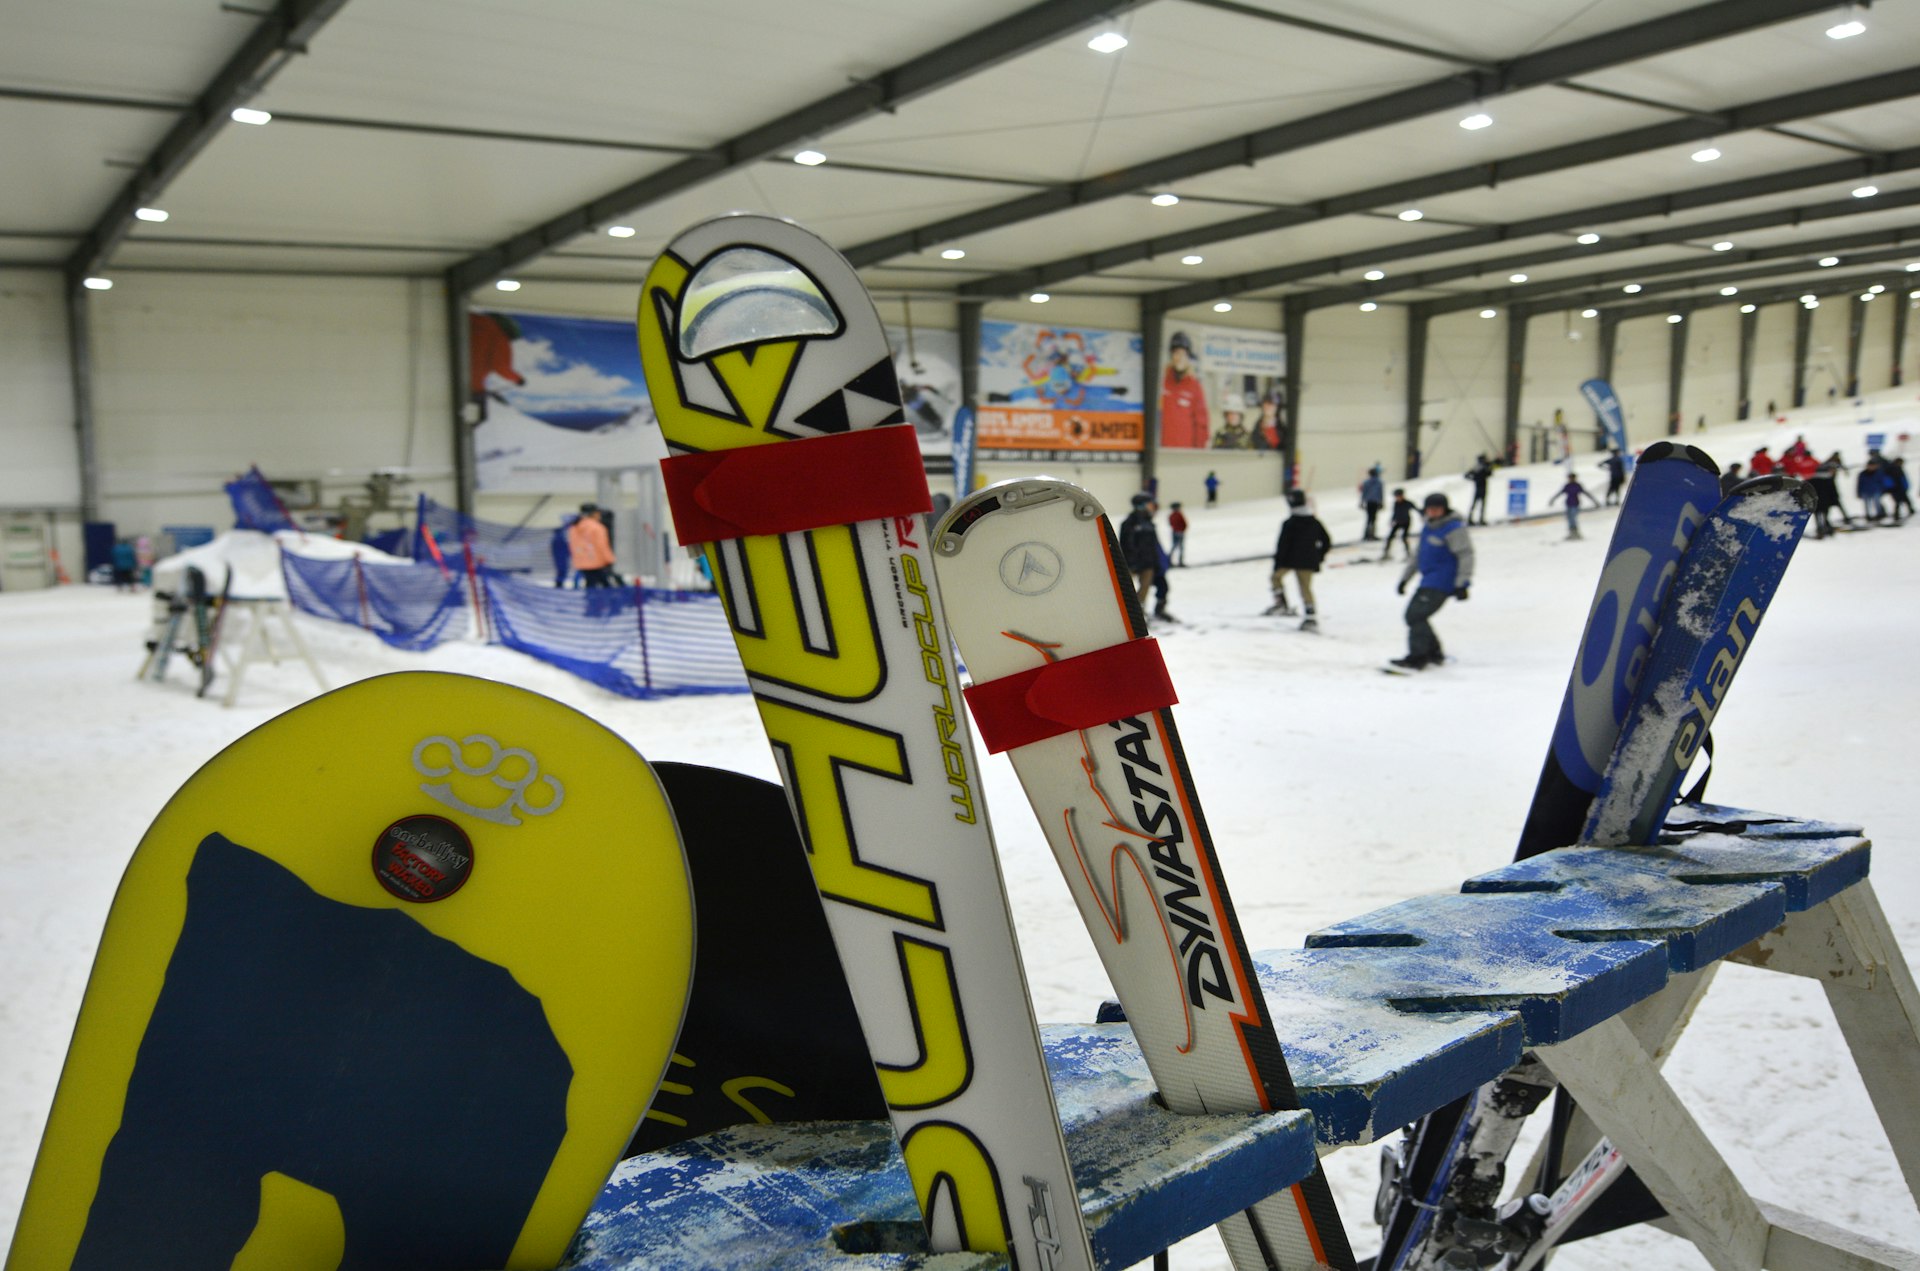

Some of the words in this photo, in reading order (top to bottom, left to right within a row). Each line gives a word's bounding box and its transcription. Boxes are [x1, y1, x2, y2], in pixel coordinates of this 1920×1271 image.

[900, 553, 977, 824] WORLDCUP
[1673, 596, 1761, 771] elan
[387, 861, 435, 897] WAXED
[391, 841, 446, 882] FACTORY
